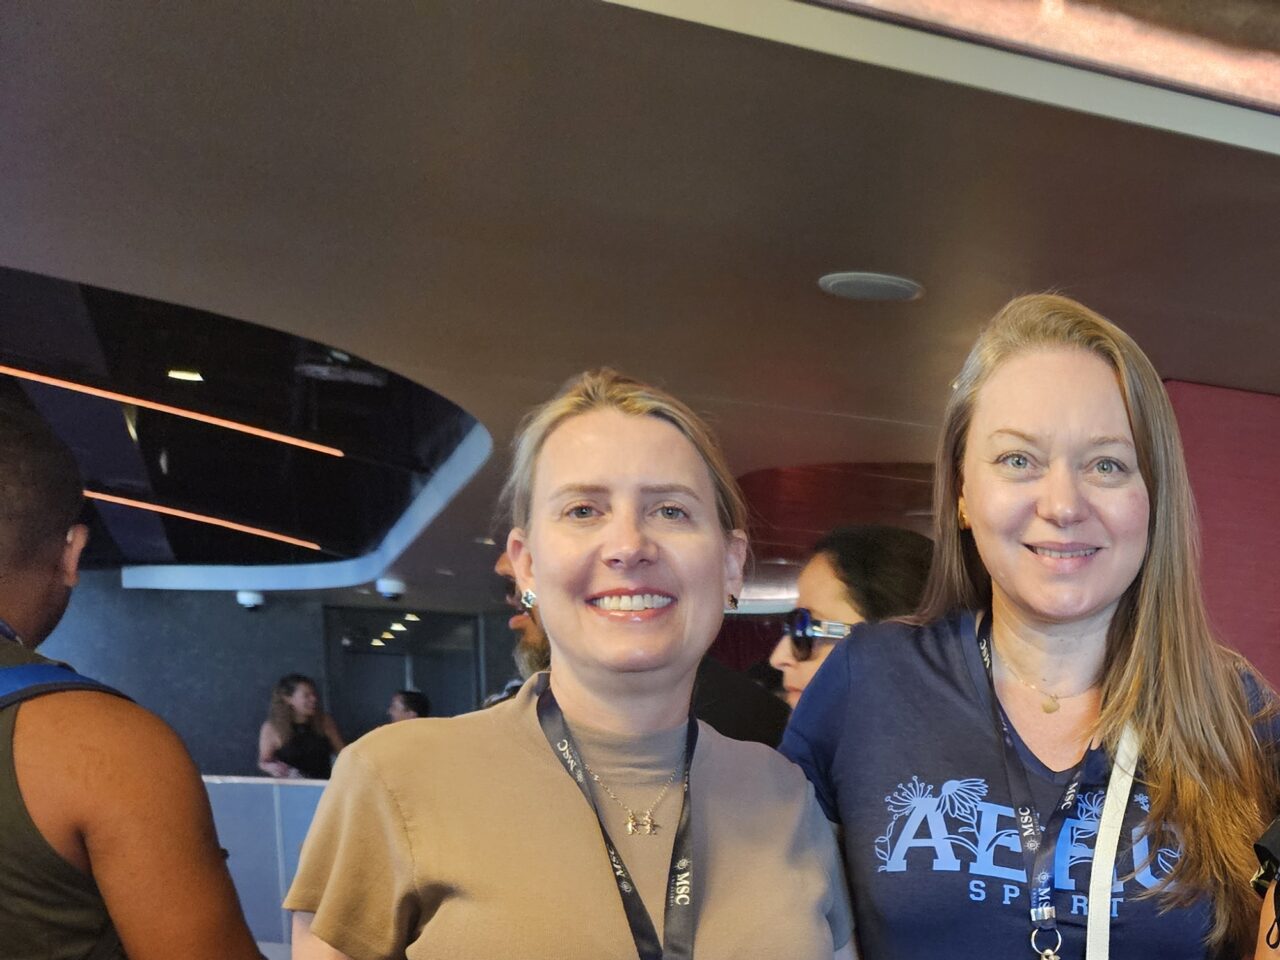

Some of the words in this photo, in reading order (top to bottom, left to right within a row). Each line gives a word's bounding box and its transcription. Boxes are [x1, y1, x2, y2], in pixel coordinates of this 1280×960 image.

[556, 739, 577, 771] MSC
[1061, 781, 1078, 811] MSC
[1018, 806, 1035, 837] MSC
[675, 872, 691, 906] MSC
[969, 880, 1124, 917] SPRT
